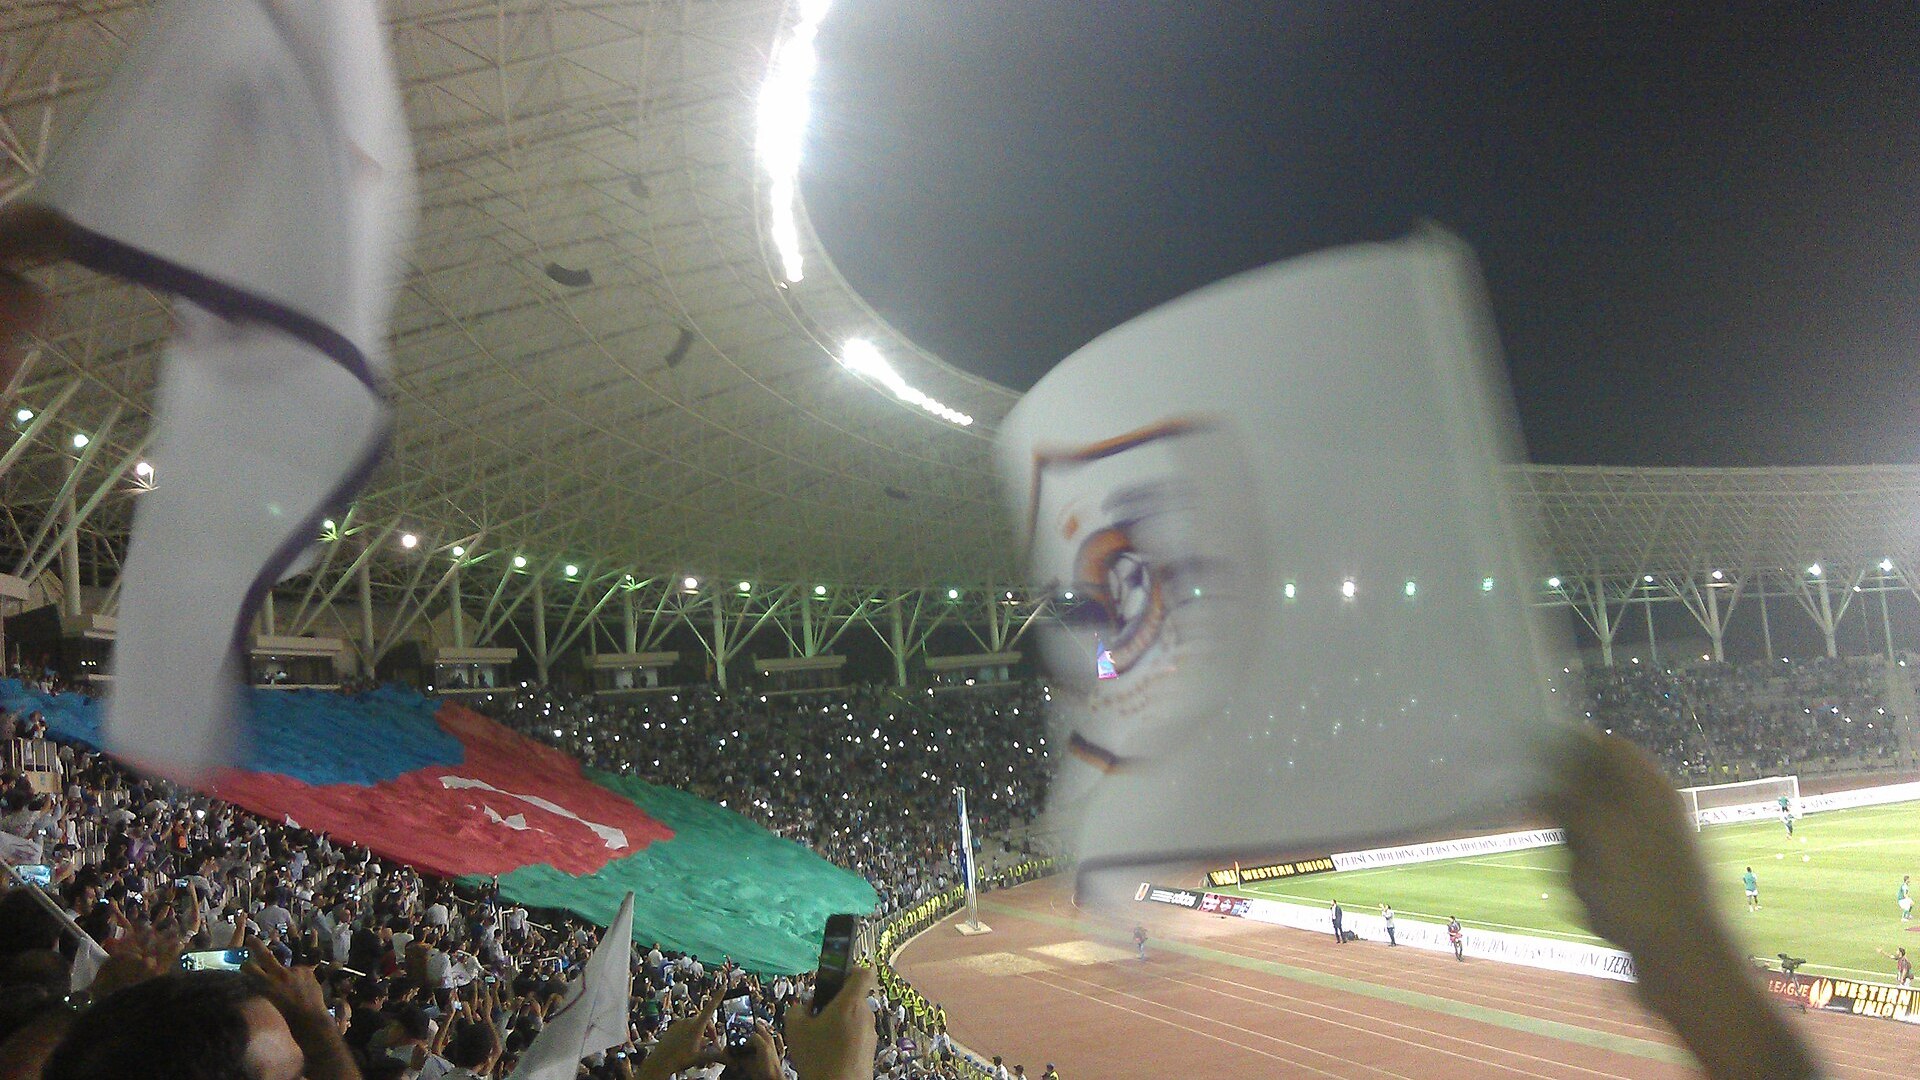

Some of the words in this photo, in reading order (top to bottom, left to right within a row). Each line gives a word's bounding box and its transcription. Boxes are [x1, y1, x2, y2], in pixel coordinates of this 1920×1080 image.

[1240, 863, 1295, 881] WESTERN
[1295, 858, 1333, 874] UNION
[1834, 980, 1912, 1006] WESTERN
[1852, 998, 1909, 1021] UNION
